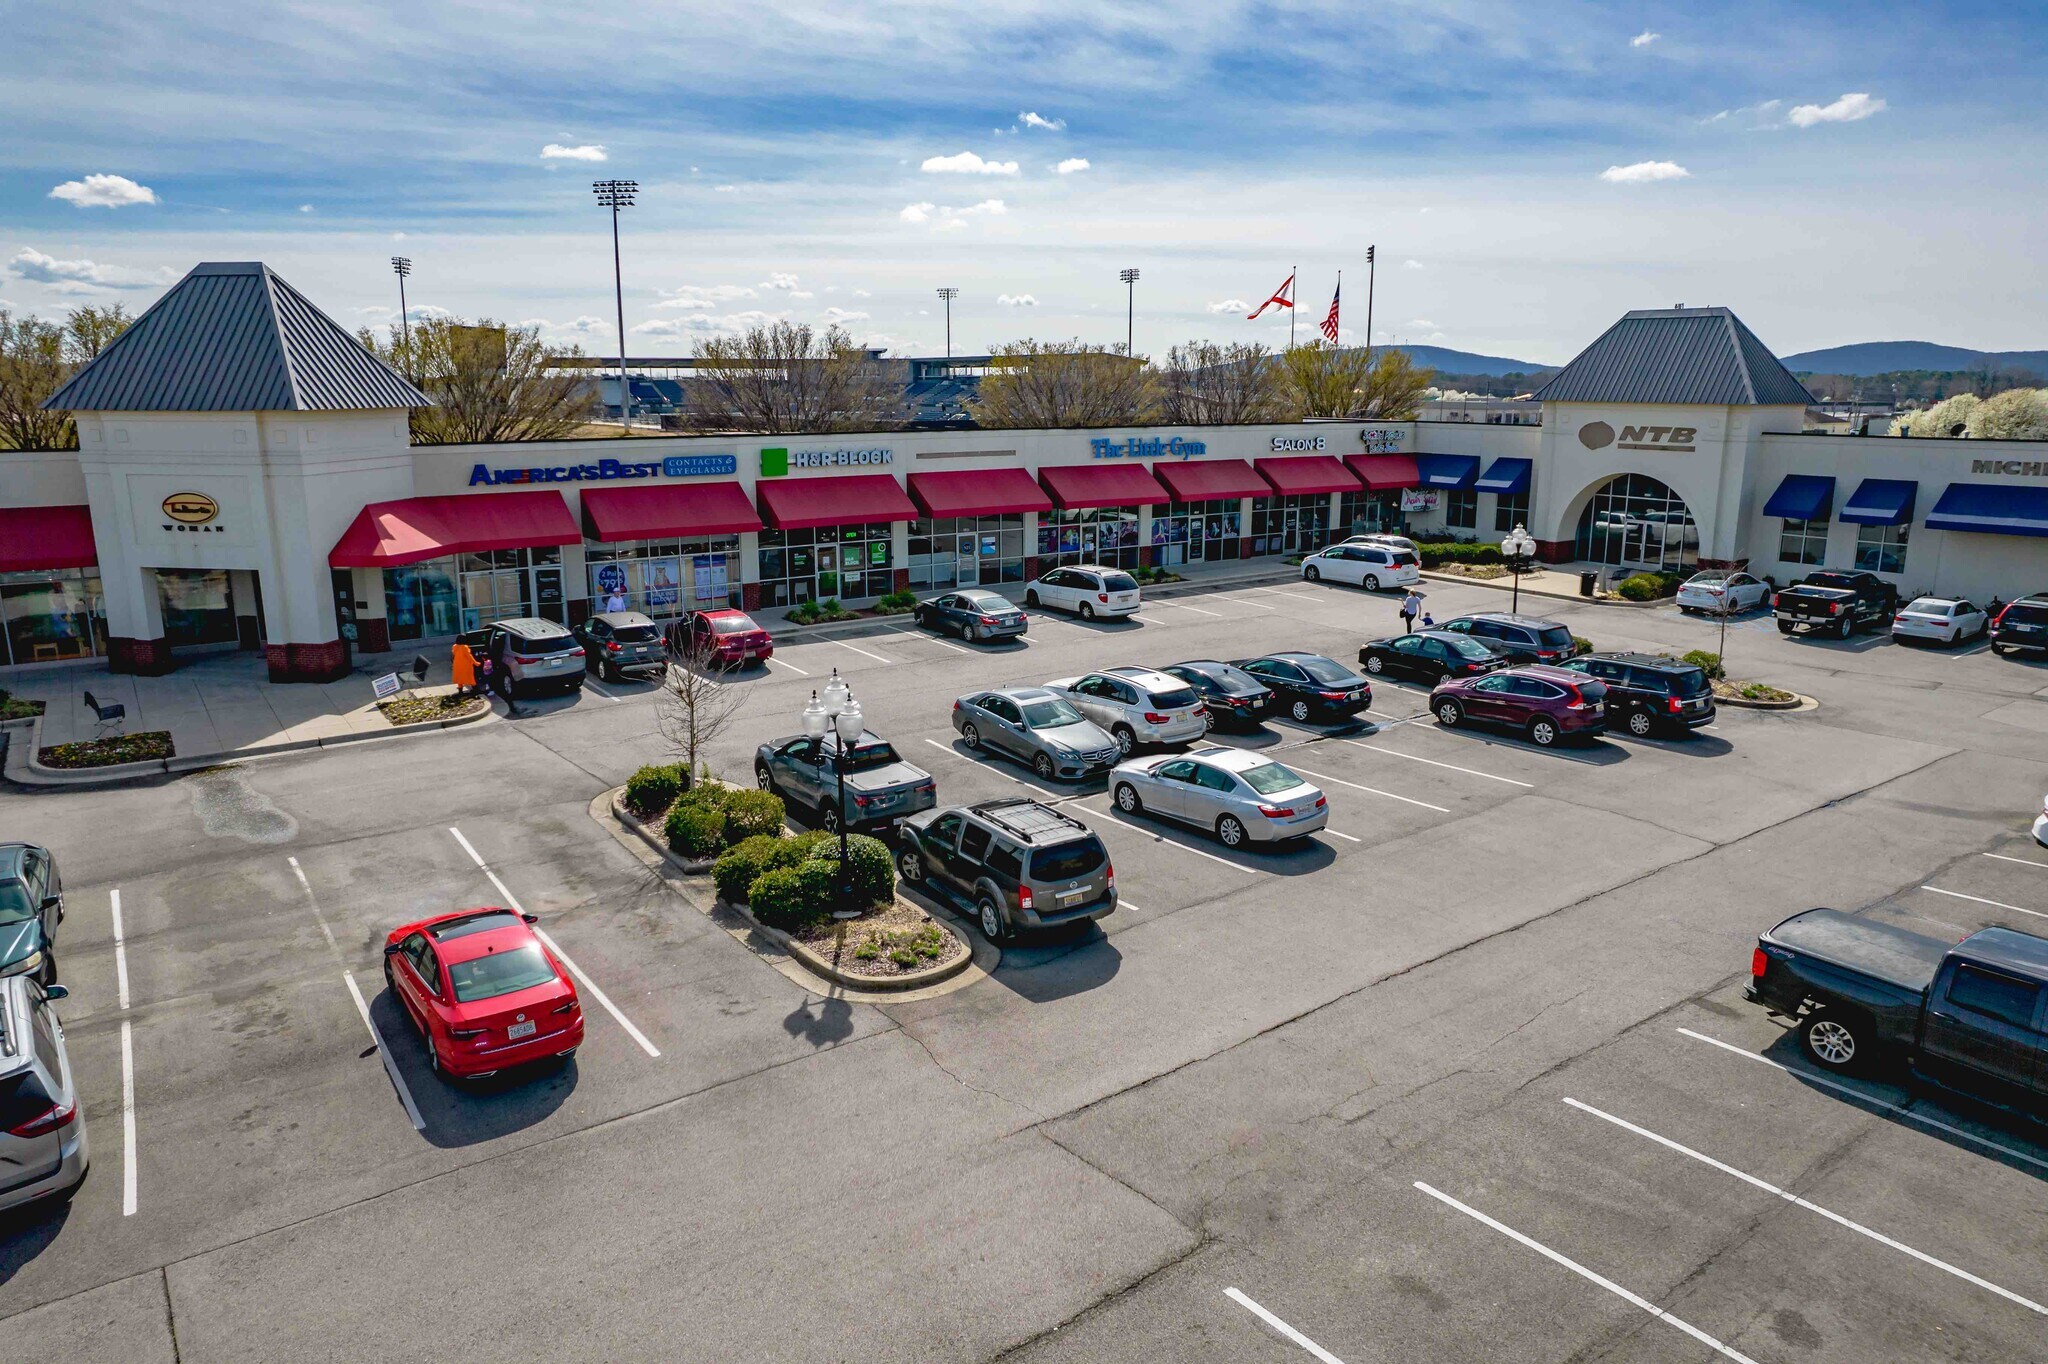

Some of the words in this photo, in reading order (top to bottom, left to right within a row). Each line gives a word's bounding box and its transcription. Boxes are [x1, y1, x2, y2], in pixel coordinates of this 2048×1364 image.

[1618, 425, 1698, 443] NTB
[1091, 438, 1124, 458] The
[1127, 437, 1167, 458] Little
[1169, 436, 1206, 461] Gym
[1272, 437, 1313, 451] SALON
[1315, 437, 1326, 450] 8
[669, 457, 723, 466] CONTACTS
[795, 452, 833, 468] H&R
[837, 449, 893, 466] BLOCK
[670, 466, 733, 475] EYEGLASSES
[162, 524, 224, 532] WOMAN
